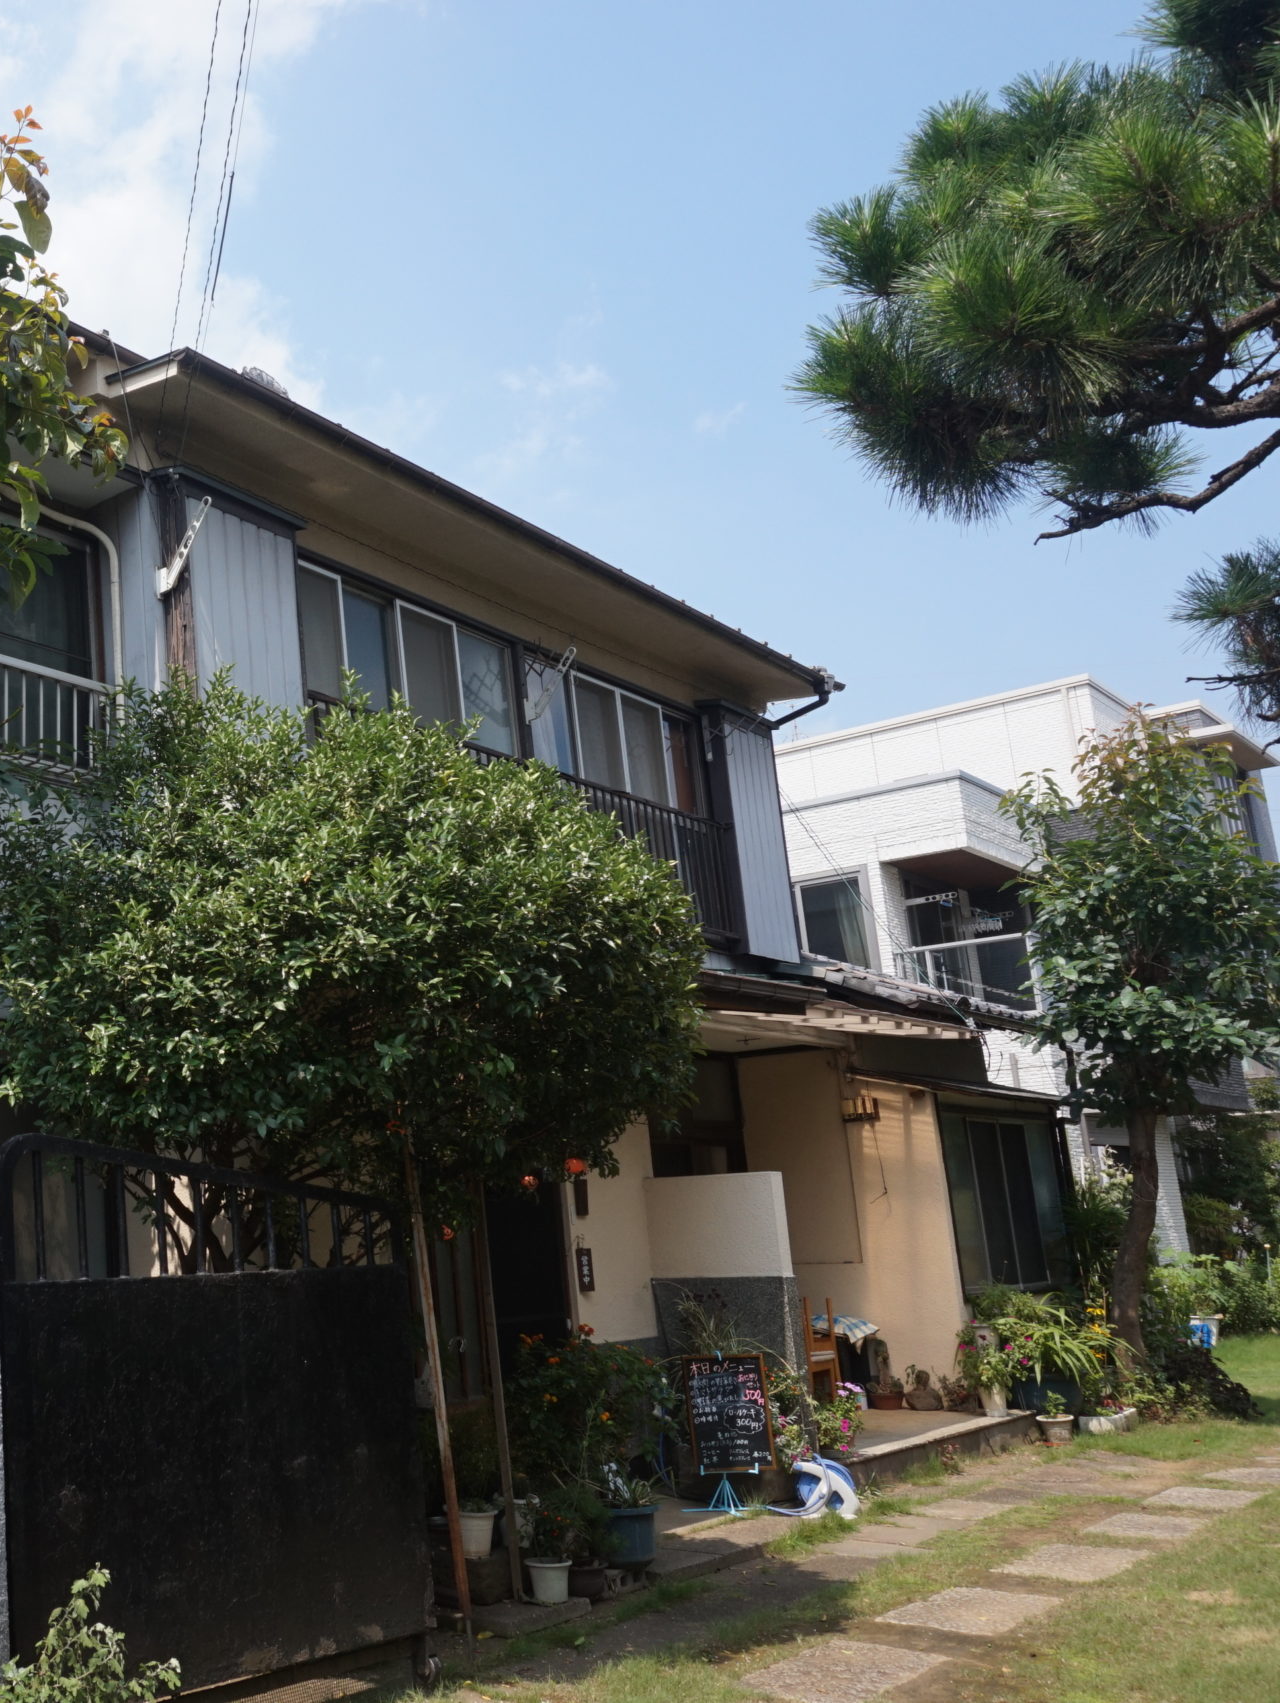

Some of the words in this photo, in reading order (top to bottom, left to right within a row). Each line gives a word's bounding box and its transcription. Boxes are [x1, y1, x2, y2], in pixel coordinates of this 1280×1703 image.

[690, 1361, 755, 1378] 本日のメニュー
[728, 1409, 756, 1418] ロールケーキ
[735, 1418, 759, 1430] 300円
